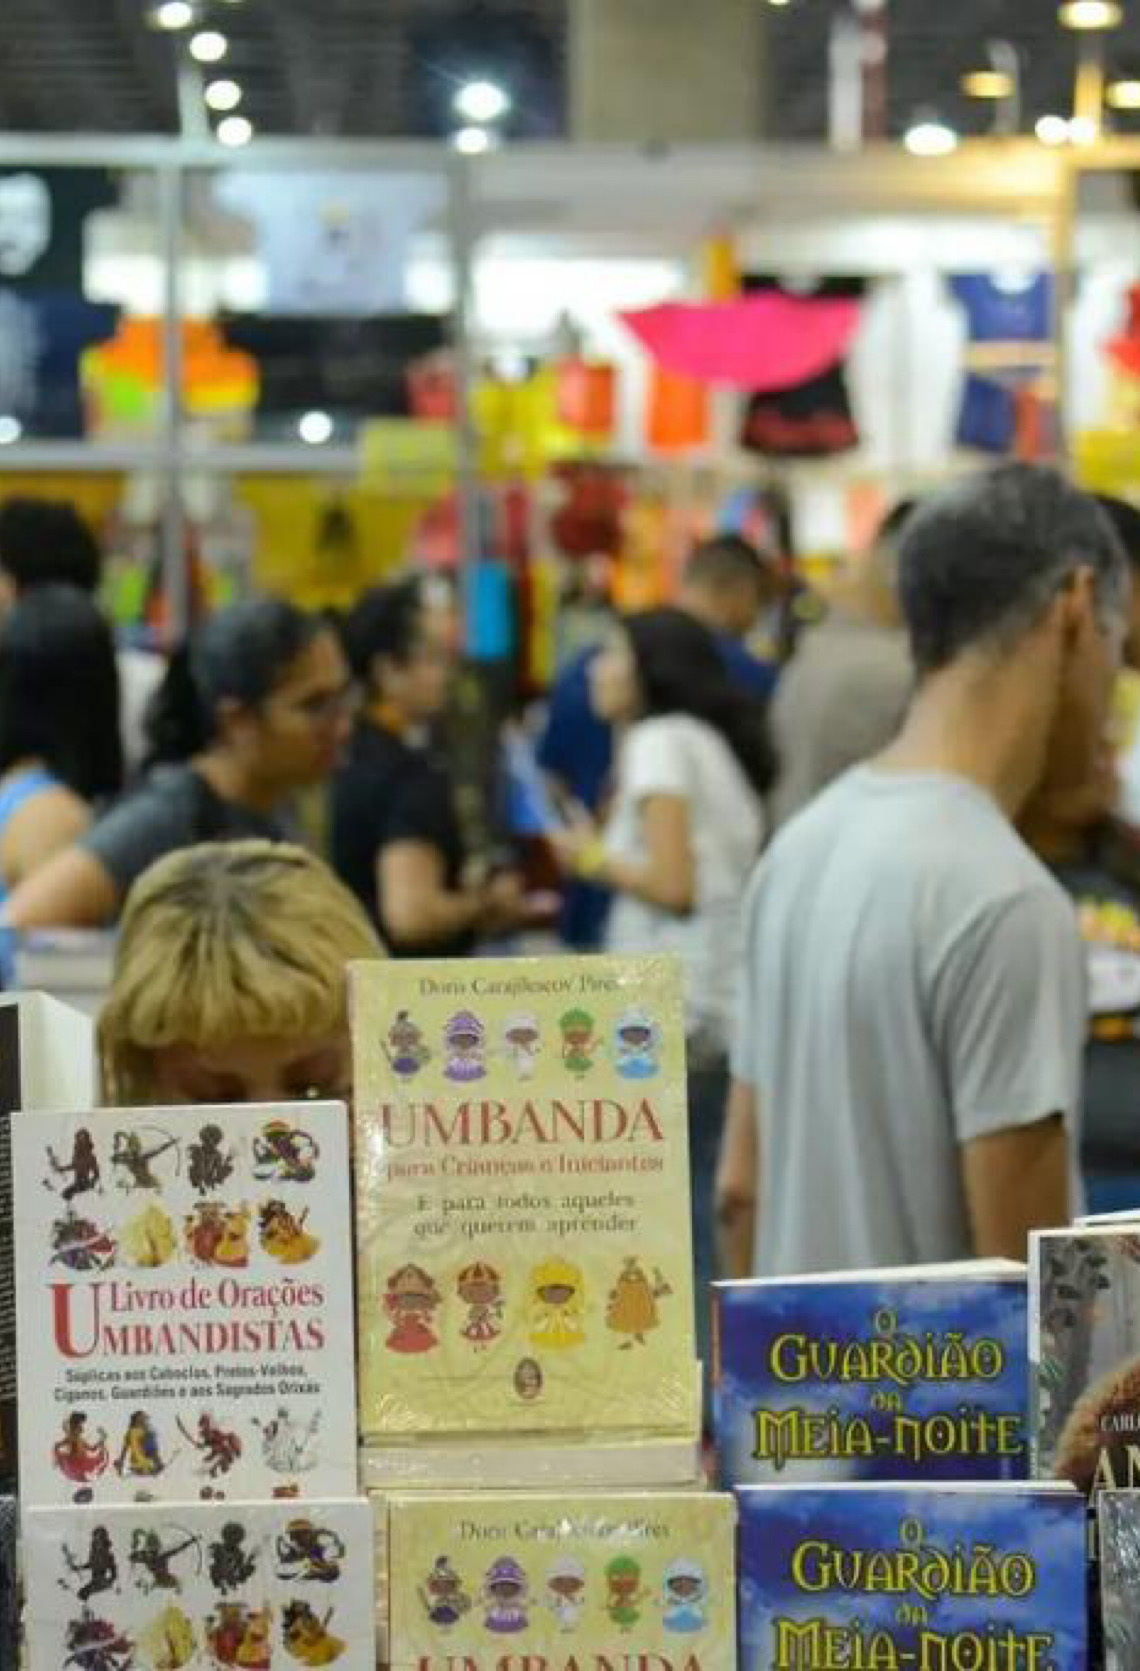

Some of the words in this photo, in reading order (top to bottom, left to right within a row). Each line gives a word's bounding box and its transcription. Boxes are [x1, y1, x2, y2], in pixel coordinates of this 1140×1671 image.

[382, 1099, 665, 1147] UMBANDA
[387, 1161, 435, 1182] para
[442, 1197, 485, 1214] para
[498, 1194, 550, 1210] todos
[561, 1190, 635, 1213] aqueles
[461, 1219, 536, 1238] querem
[547, 1214, 636, 1237] aprender
[110, 1282, 174, 1312] Livro
[180, 1277, 211, 1310] de
[218, 1277, 325, 1317] Orações
[47, 1282, 325, 1358] UMBANDISTAS
[875, 1309, 897, 1333] O
[902, 1518, 922, 1543] O
